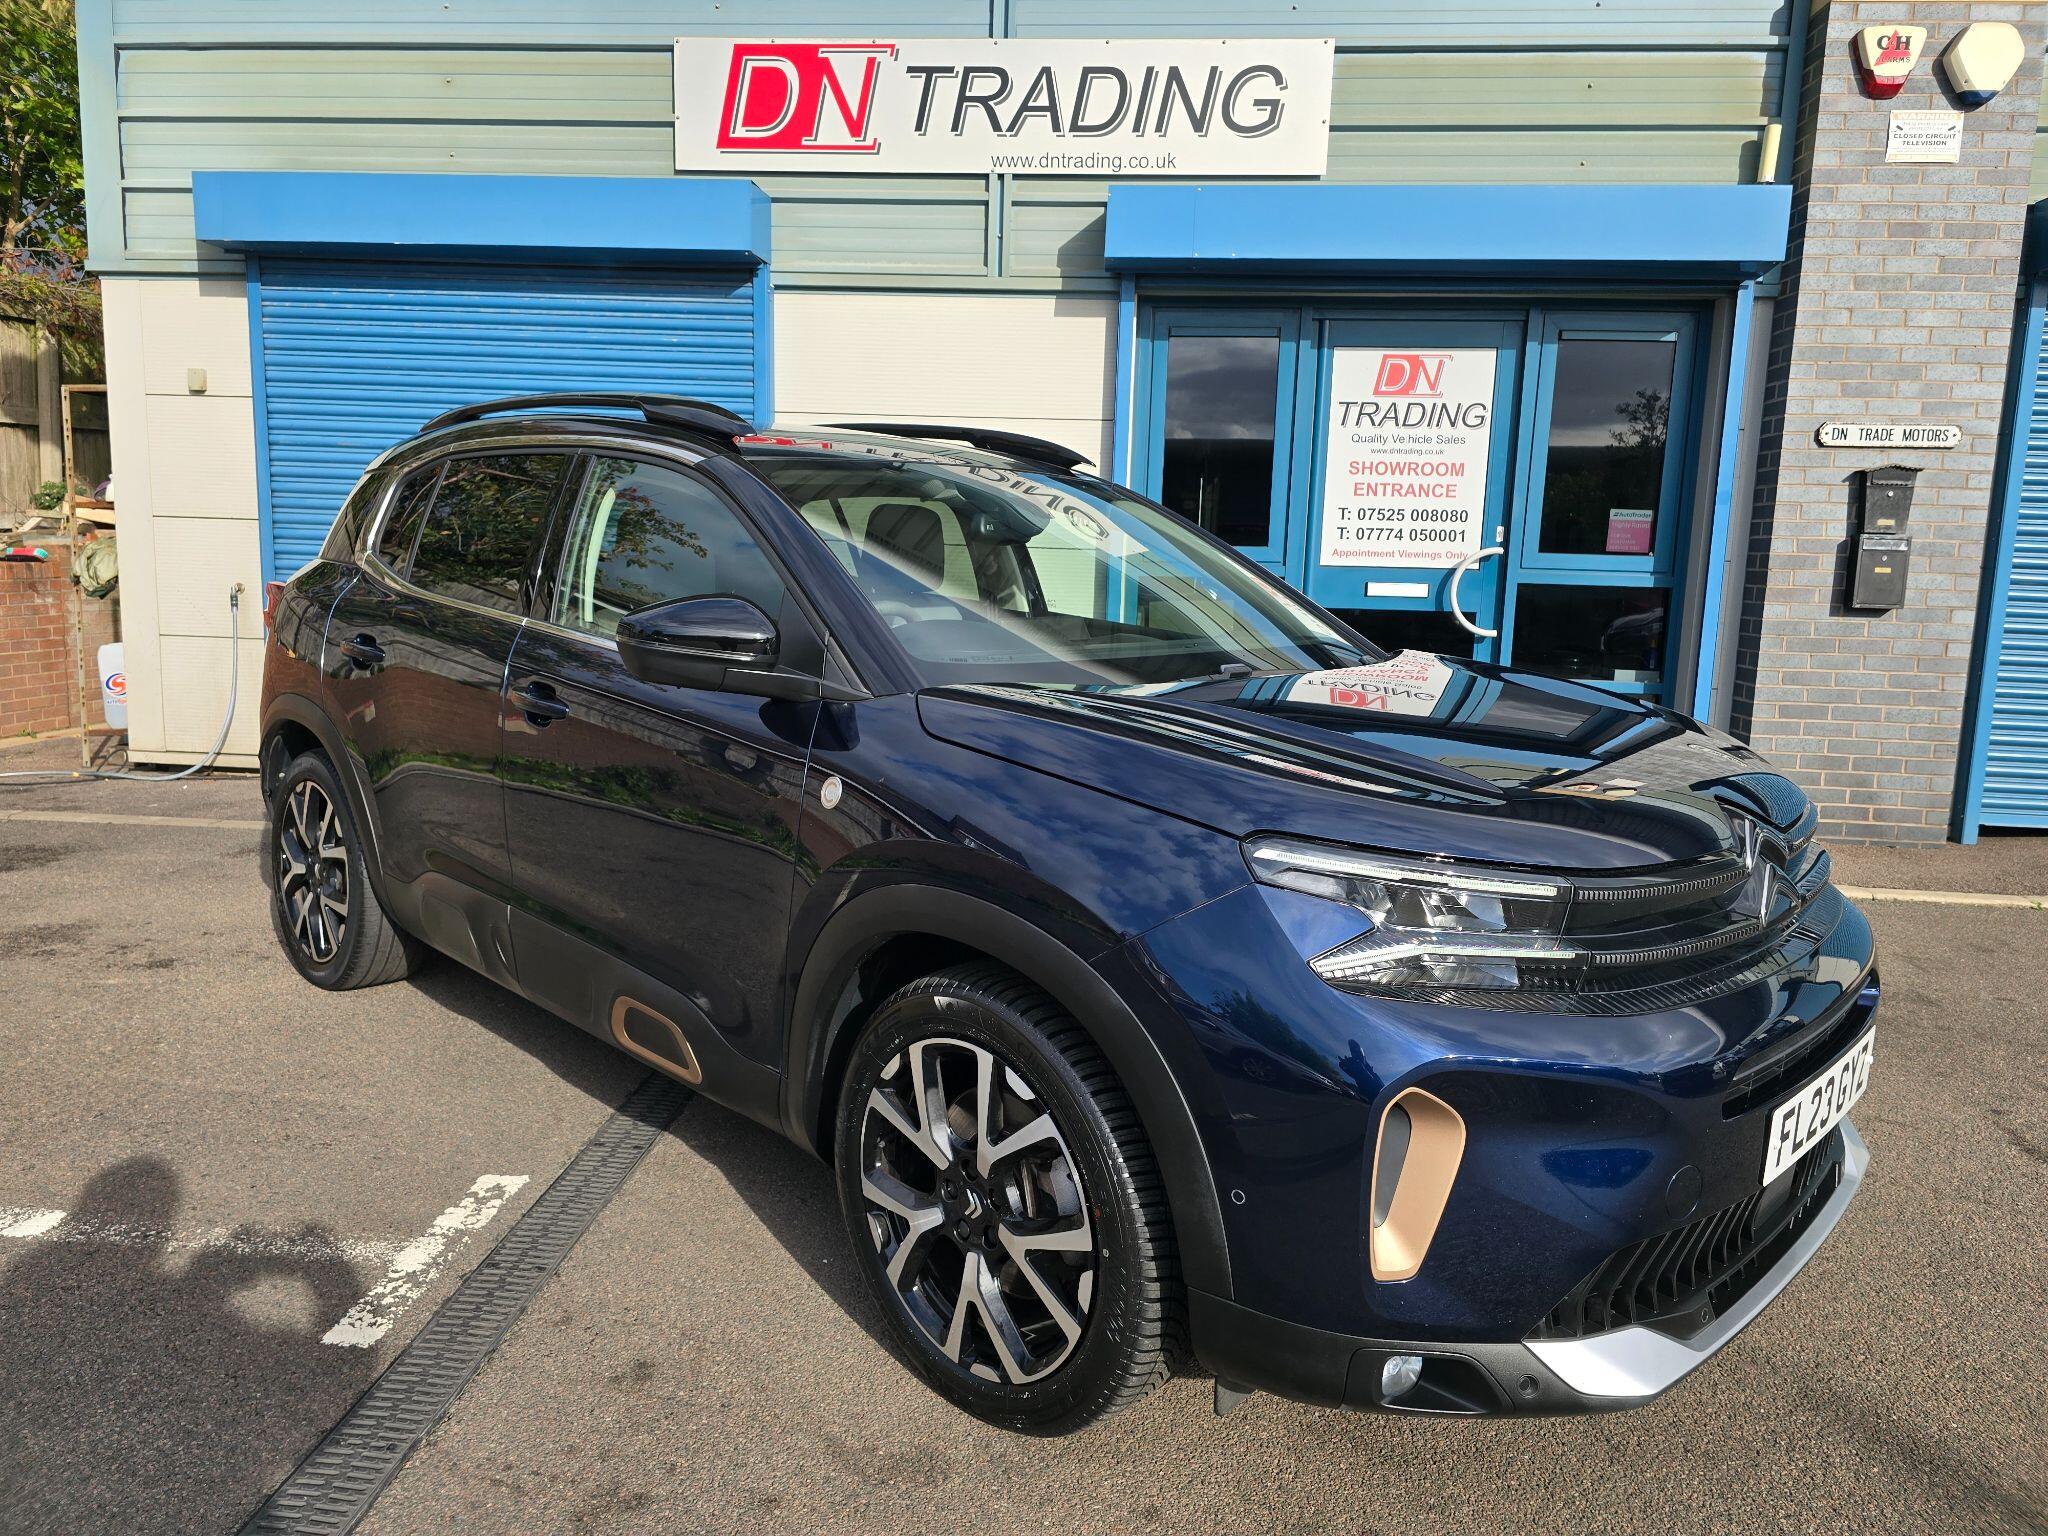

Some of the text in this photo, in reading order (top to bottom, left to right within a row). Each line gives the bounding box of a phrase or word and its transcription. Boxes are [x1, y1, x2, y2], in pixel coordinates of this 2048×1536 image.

[716, 43, 1289, 154] DN TRADING
[991, 152, 1177, 173] www.dntrading.co.uk
[1373, 354, 1454, 398] DN
[1338, 401, 1488, 429] TRADING
[1351, 433, 1466, 445] Quality Vehicle Sales
[1832, 427, 1949, 442] DN TRADE MOTORS
[1370, 447, 1444, 456] www.dntrading.co.uk
[1348, 460, 1465, 477] SHOWROOM
[1353, 482, 1457, 498] ENTRANCE
[1338, 507, 1469, 523] T: 07525 008080
[1337, 527, 1466, 543] T: 07774 050001
[1332, 548, 1395, 559] Appointment
[1398, 550, 1442, 560] Viewings
[1776, 1040, 1869, 1168] FL23 GYZ
